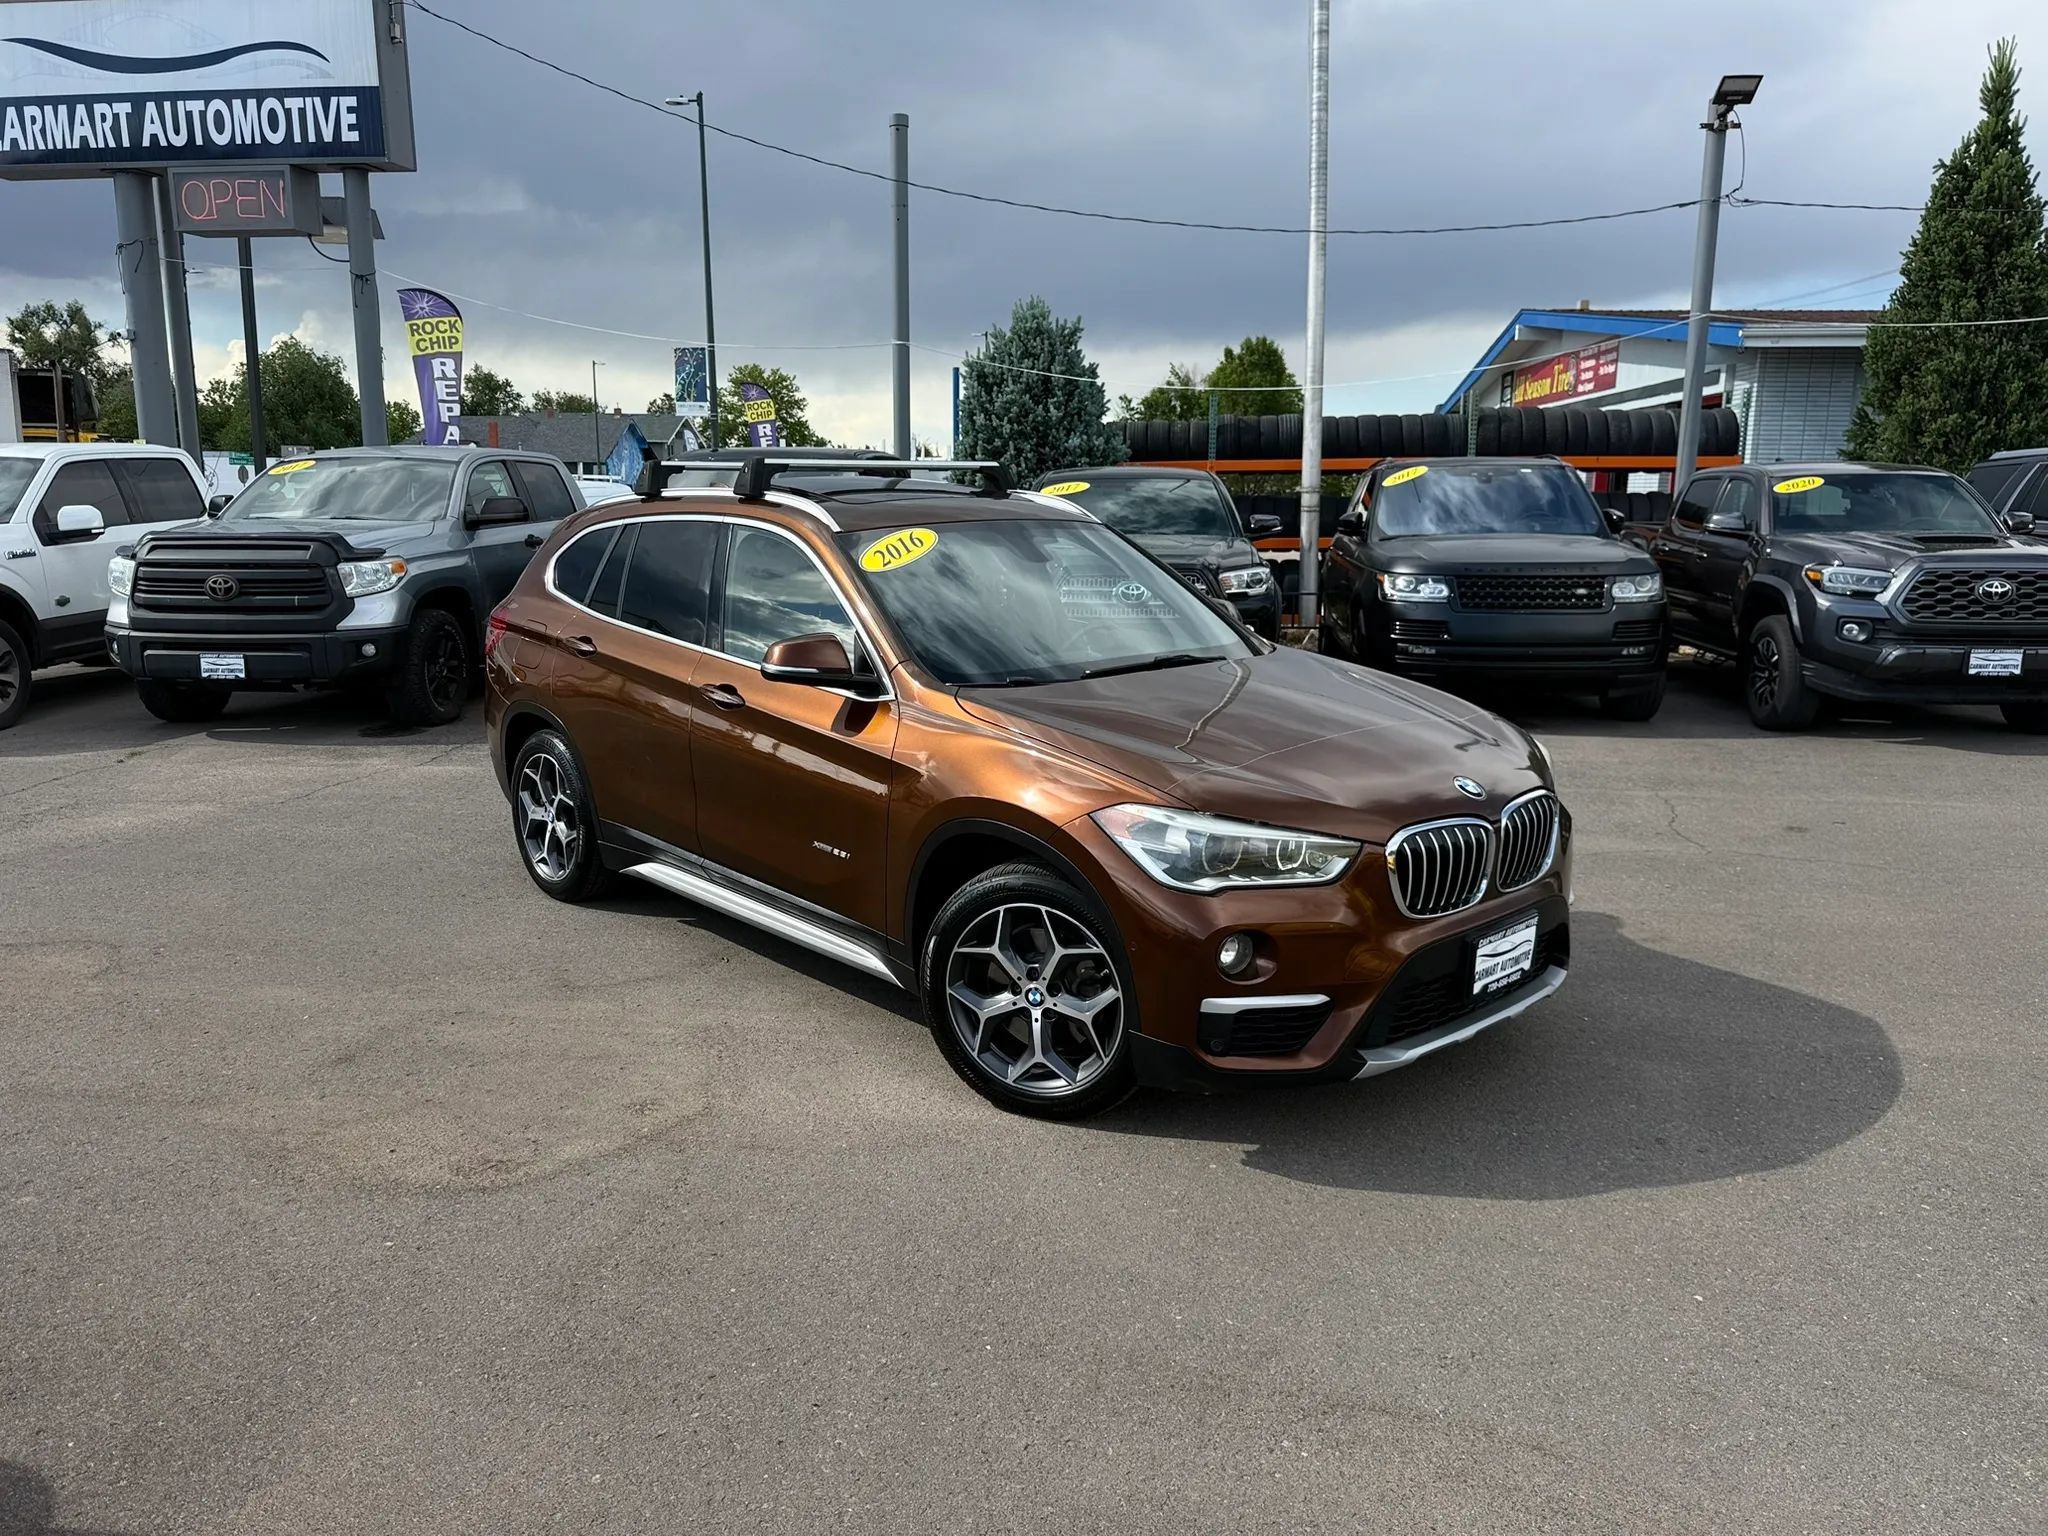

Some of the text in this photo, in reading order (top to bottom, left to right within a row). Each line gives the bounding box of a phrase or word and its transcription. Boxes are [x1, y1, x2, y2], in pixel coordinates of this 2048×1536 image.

[0, 96, 360, 150] ARMART AUTOMOTIVE
[181, 179, 286, 220] OPEN
[408, 319, 461, 337] ROCK
[415, 335, 460, 353] CHIP
[746, 400, 773, 412] ROCK
[749, 410, 773, 421] CHIP
[1047, 483, 1081, 495] 2017
[1785, 478, 1816, 491] 2020
[873, 531, 924, 568] 2016
[1992, 663, 2020, 671] AUTOMOTIVE
[1478, 916, 1539, 948] CARMART AUTOMOTIVE
[1475, 948, 1532, 981] CARMART AUTOMOTIVE
